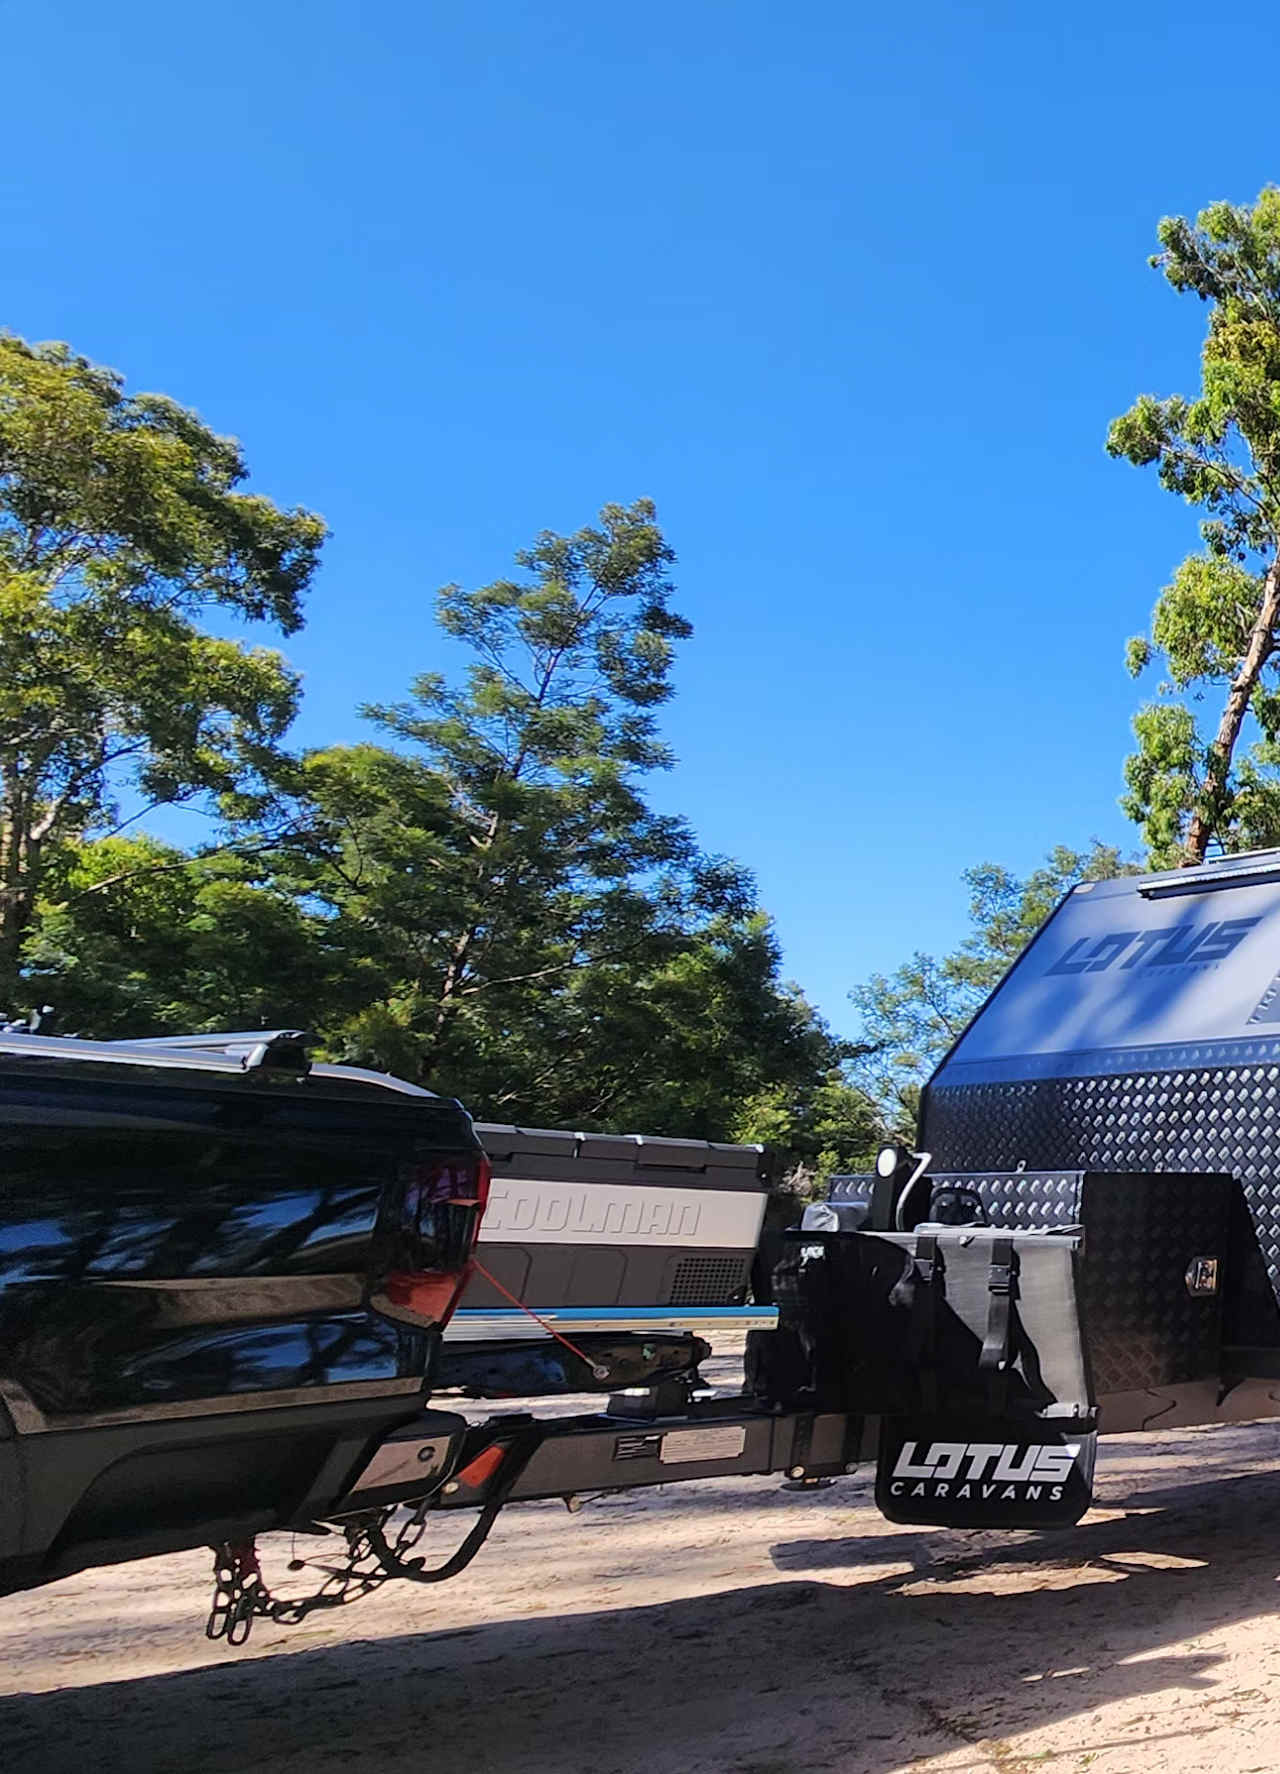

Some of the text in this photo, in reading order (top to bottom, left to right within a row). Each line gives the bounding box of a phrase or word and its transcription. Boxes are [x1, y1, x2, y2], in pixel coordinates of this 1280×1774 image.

[1040, 916, 1265, 977] LOTUS
[479, 1191, 702, 1237] COOLMAN
[892, 1441, 1081, 1483] LOTUS
[890, 1481, 1064, 1501] CARAVANS
